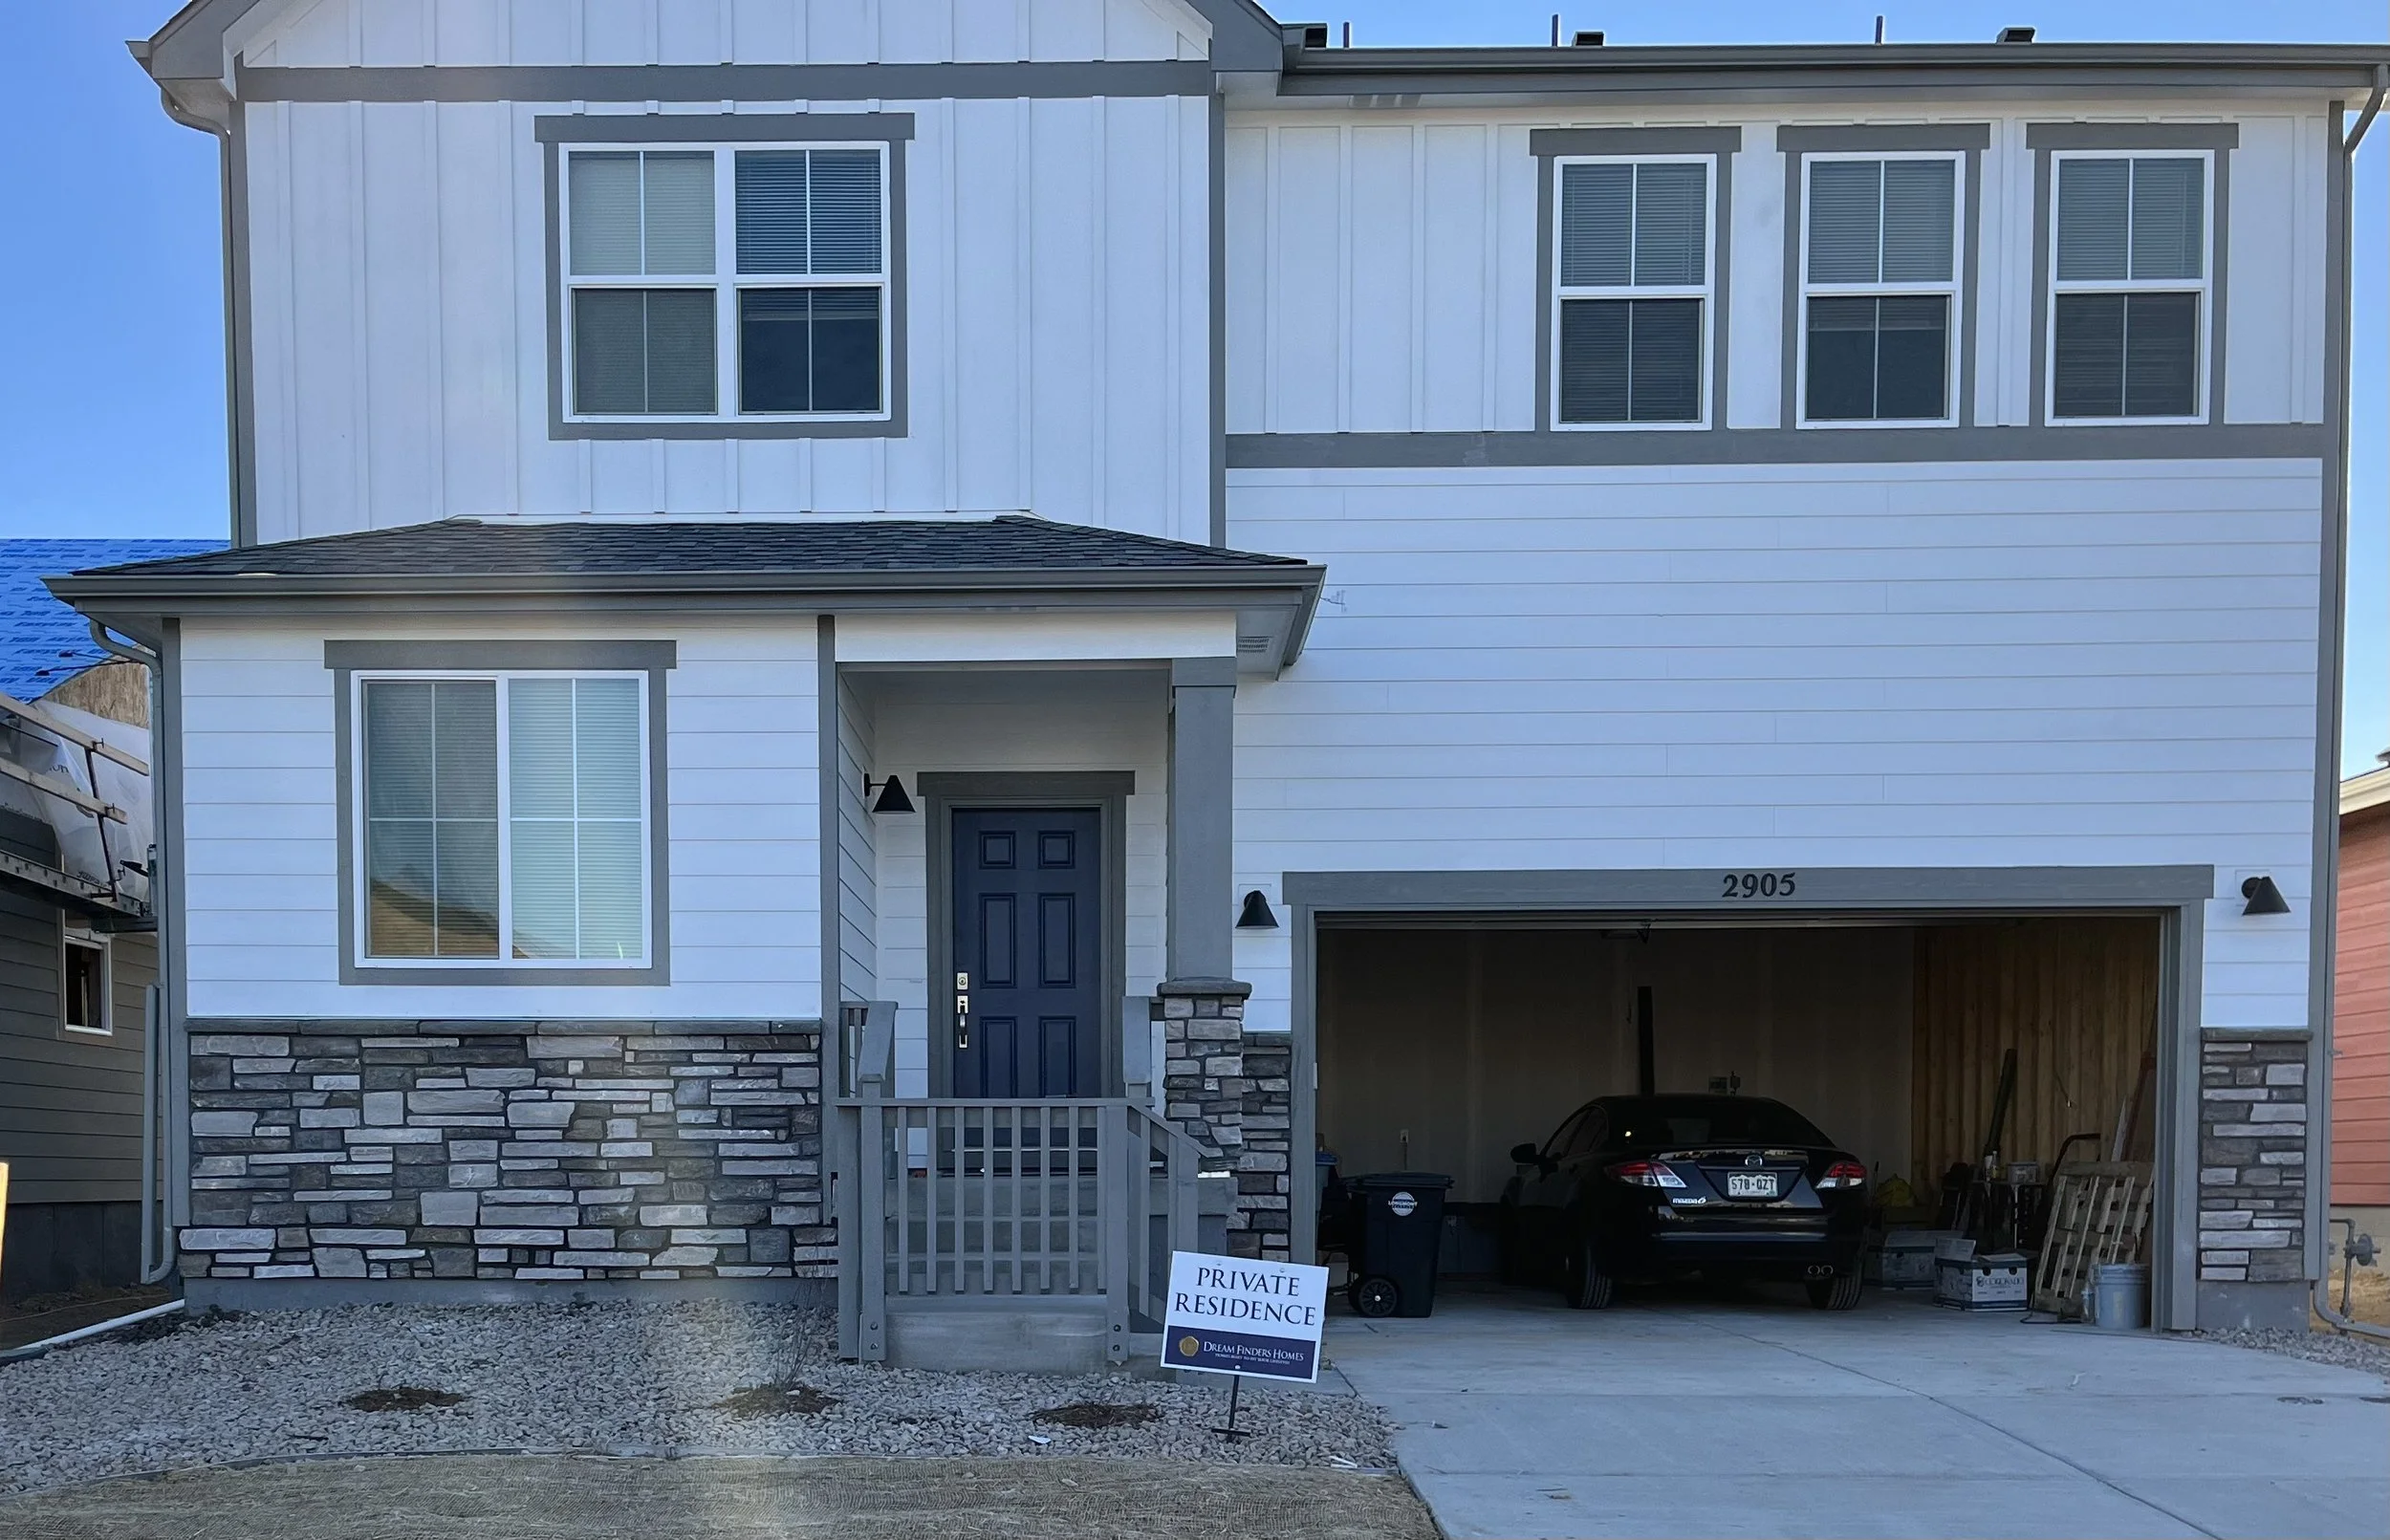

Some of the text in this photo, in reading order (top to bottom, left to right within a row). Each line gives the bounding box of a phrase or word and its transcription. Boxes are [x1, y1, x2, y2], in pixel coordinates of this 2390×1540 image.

[1722, 872, 1796, 898] 2905
[1197, 1267, 1300, 1297] PRIVATE
[1175, 1292, 1316, 1326] RESIDENCE
[1204, 1341, 1235, 1354] DREAM
[1236, 1345, 1271, 1358] FINDERS
[1273, 1349, 1304, 1362] HOMES
